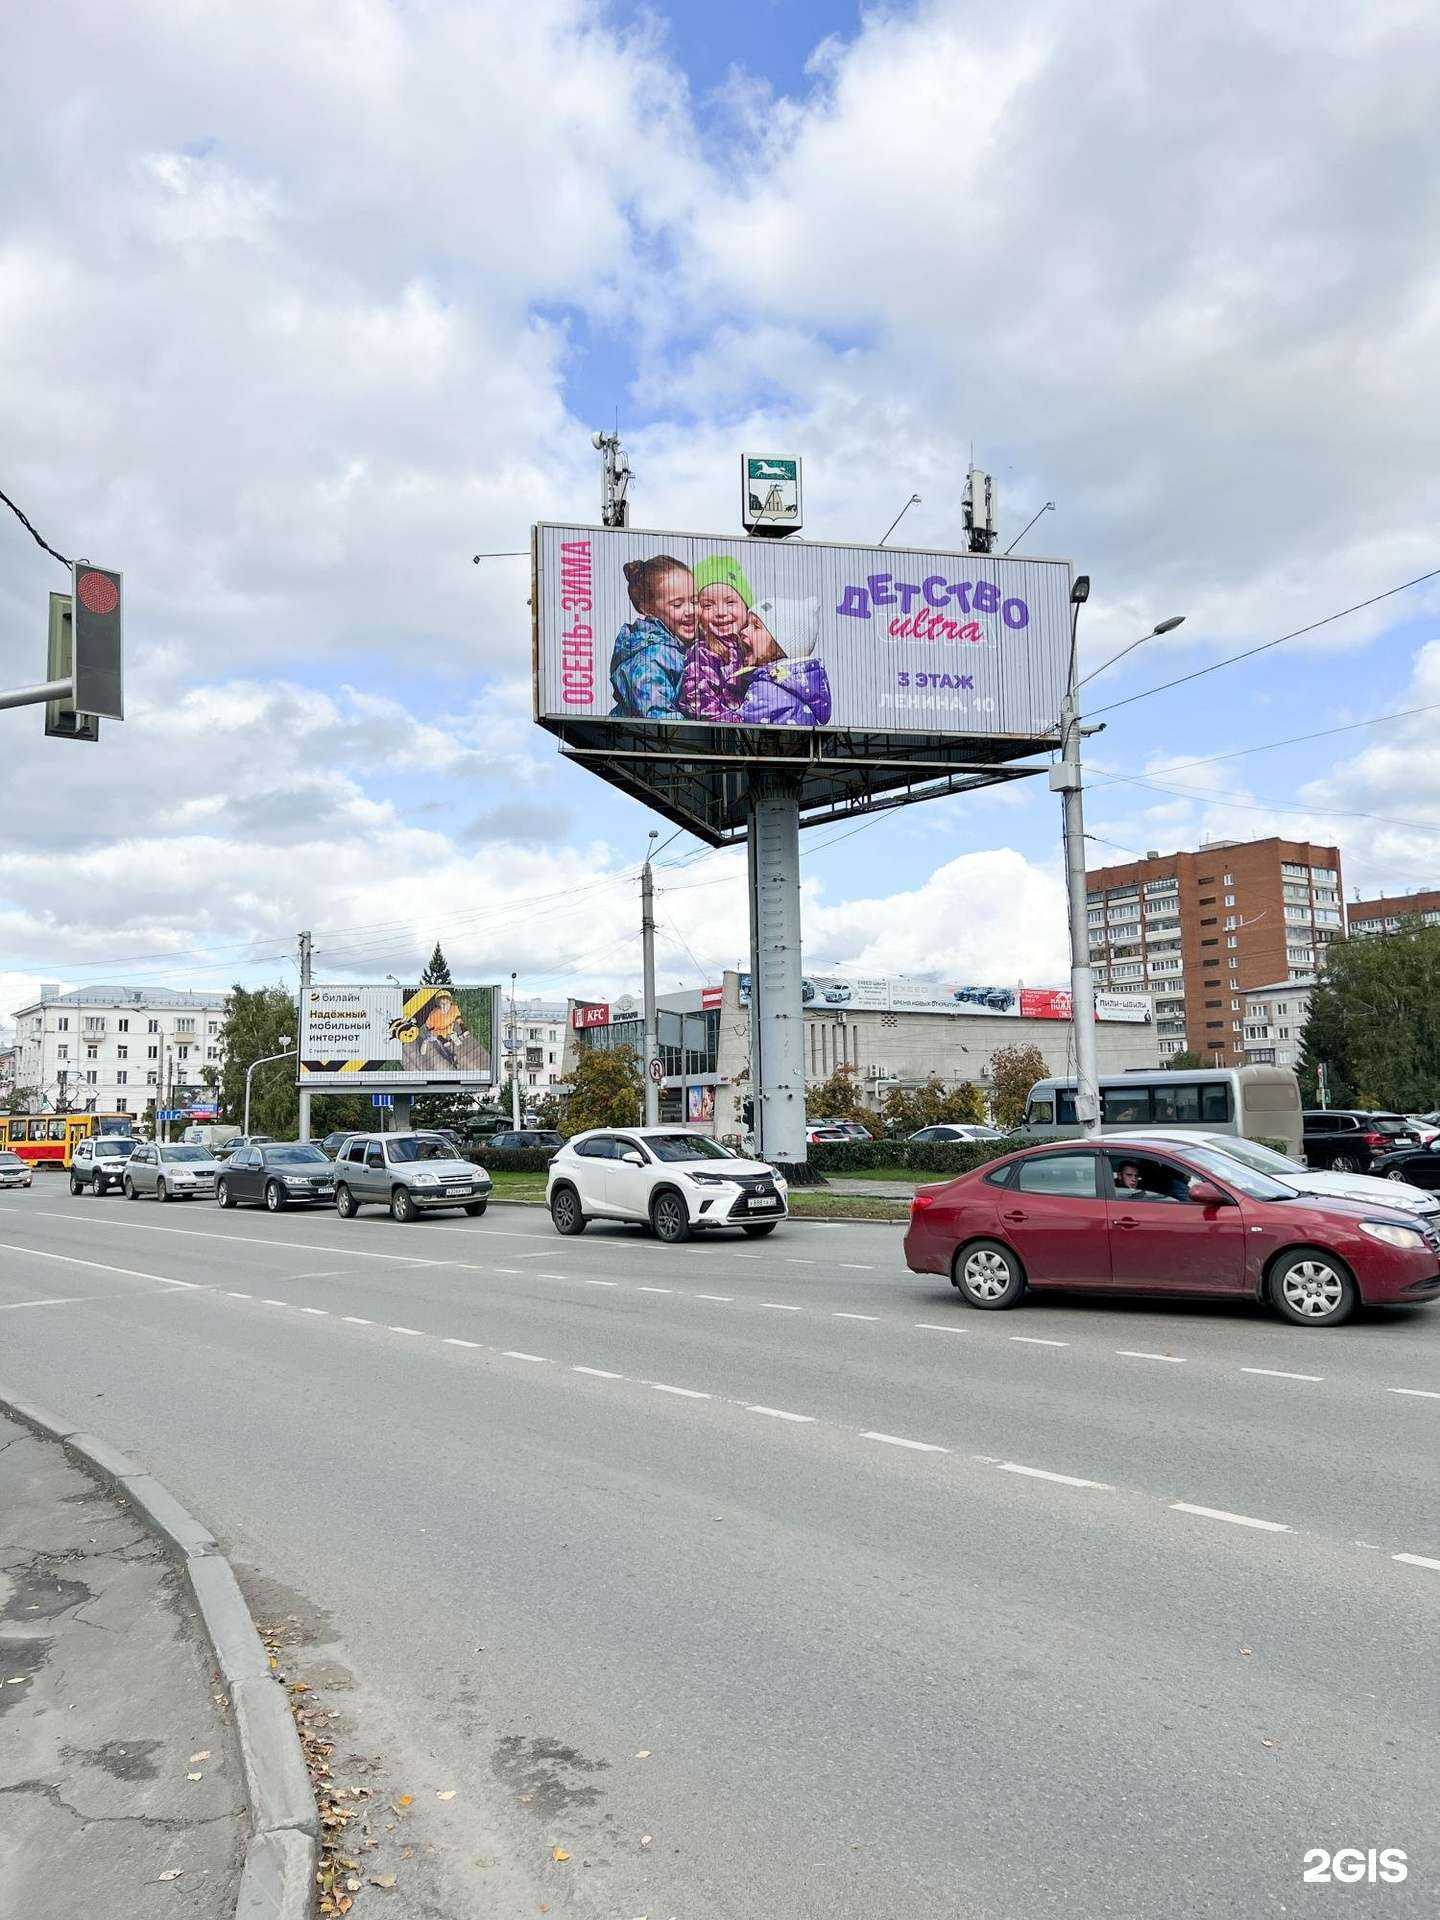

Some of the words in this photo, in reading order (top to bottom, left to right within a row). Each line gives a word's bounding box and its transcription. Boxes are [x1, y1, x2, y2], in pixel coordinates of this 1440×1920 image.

[835, 573, 1030, 630] ДЕТСТВО
[560, 540, 594, 705] ОСЕНЬ-ЗИМА
[888, 607, 984, 642] ultra
[897, 671, 910, 688] 3
[915, 672, 975, 690] ЭТАЖ
[974, 697, 995, 713] 10
[322, 992, 360, 1002] билайн
[310, 1009, 367, 1020] Надёжный
[587, 1008, 605, 1021] KFC
[309, 1021, 371, 1030] мобильный
[309, 1034, 360, 1044] интернет
